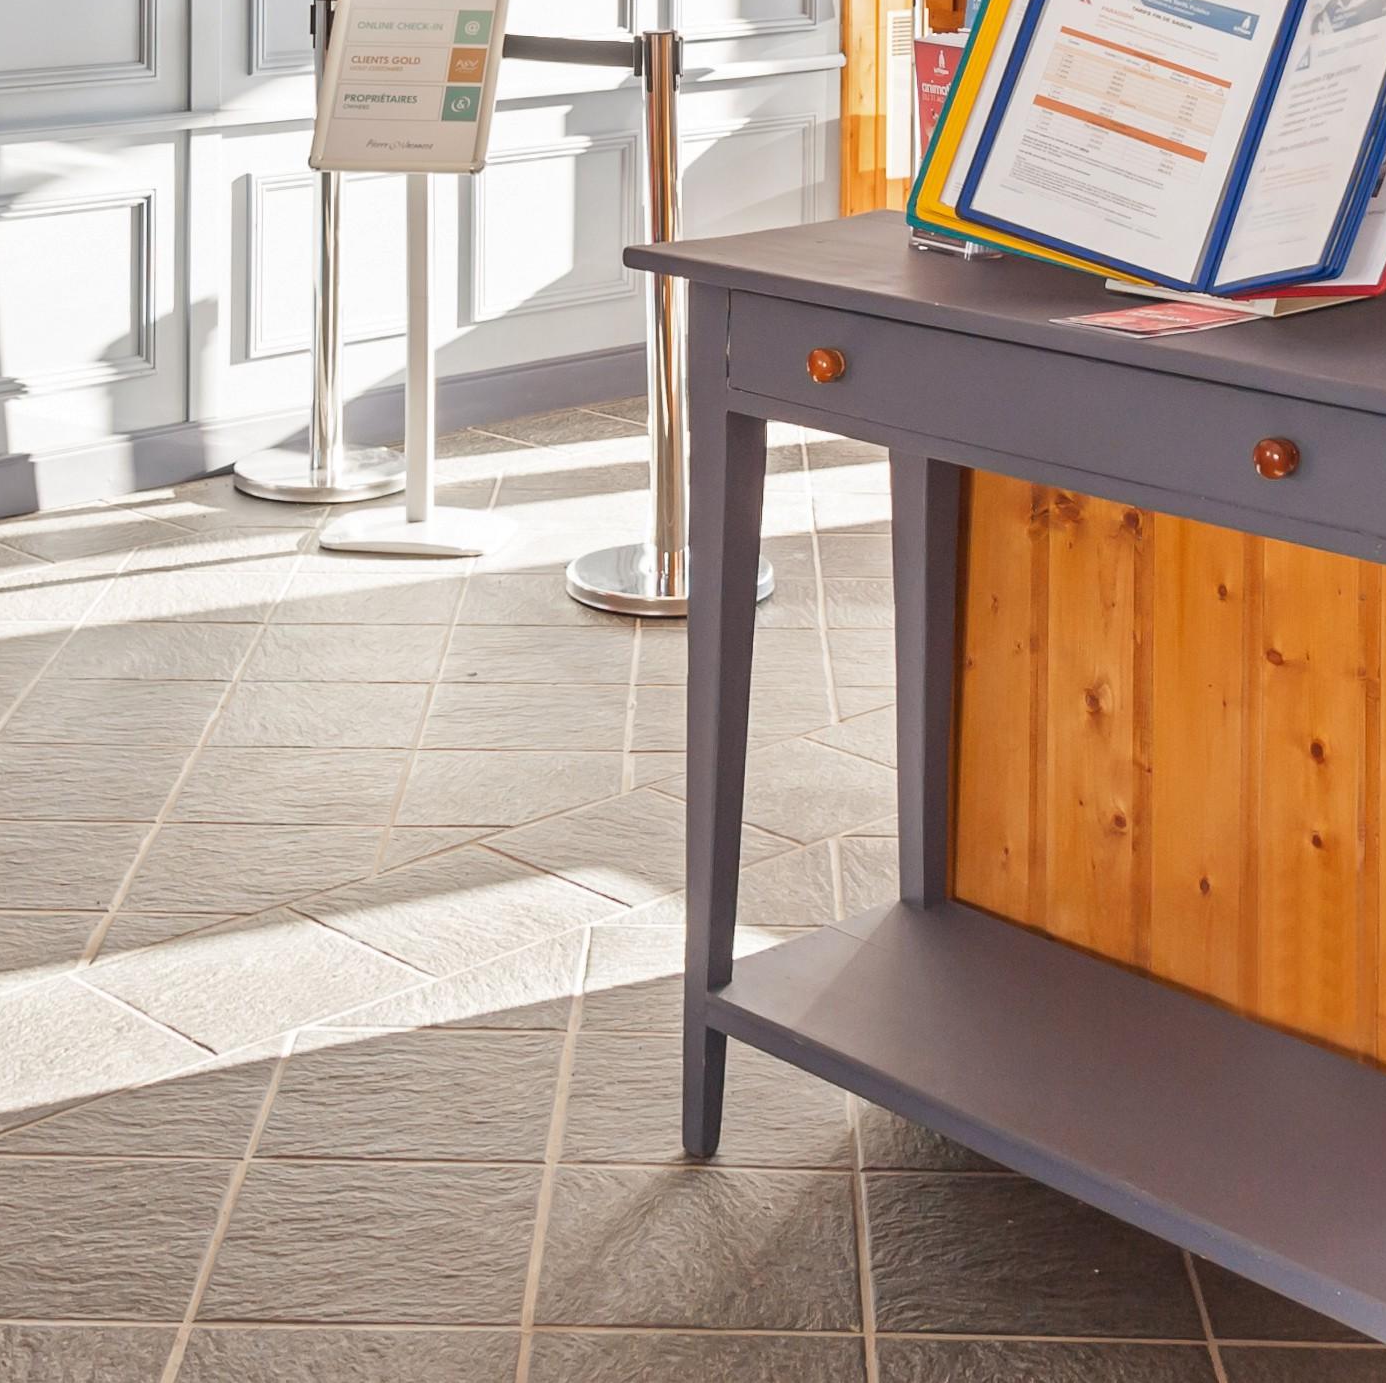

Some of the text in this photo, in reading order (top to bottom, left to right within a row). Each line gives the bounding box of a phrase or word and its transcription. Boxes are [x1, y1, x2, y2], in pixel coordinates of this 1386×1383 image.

[358, 20, 444, 31] ONLINE CHECK-IN
[351, 55, 421, 66] CLIENTS GOLD
[344, 93, 418, 104] PROPRIÉTAIRES
